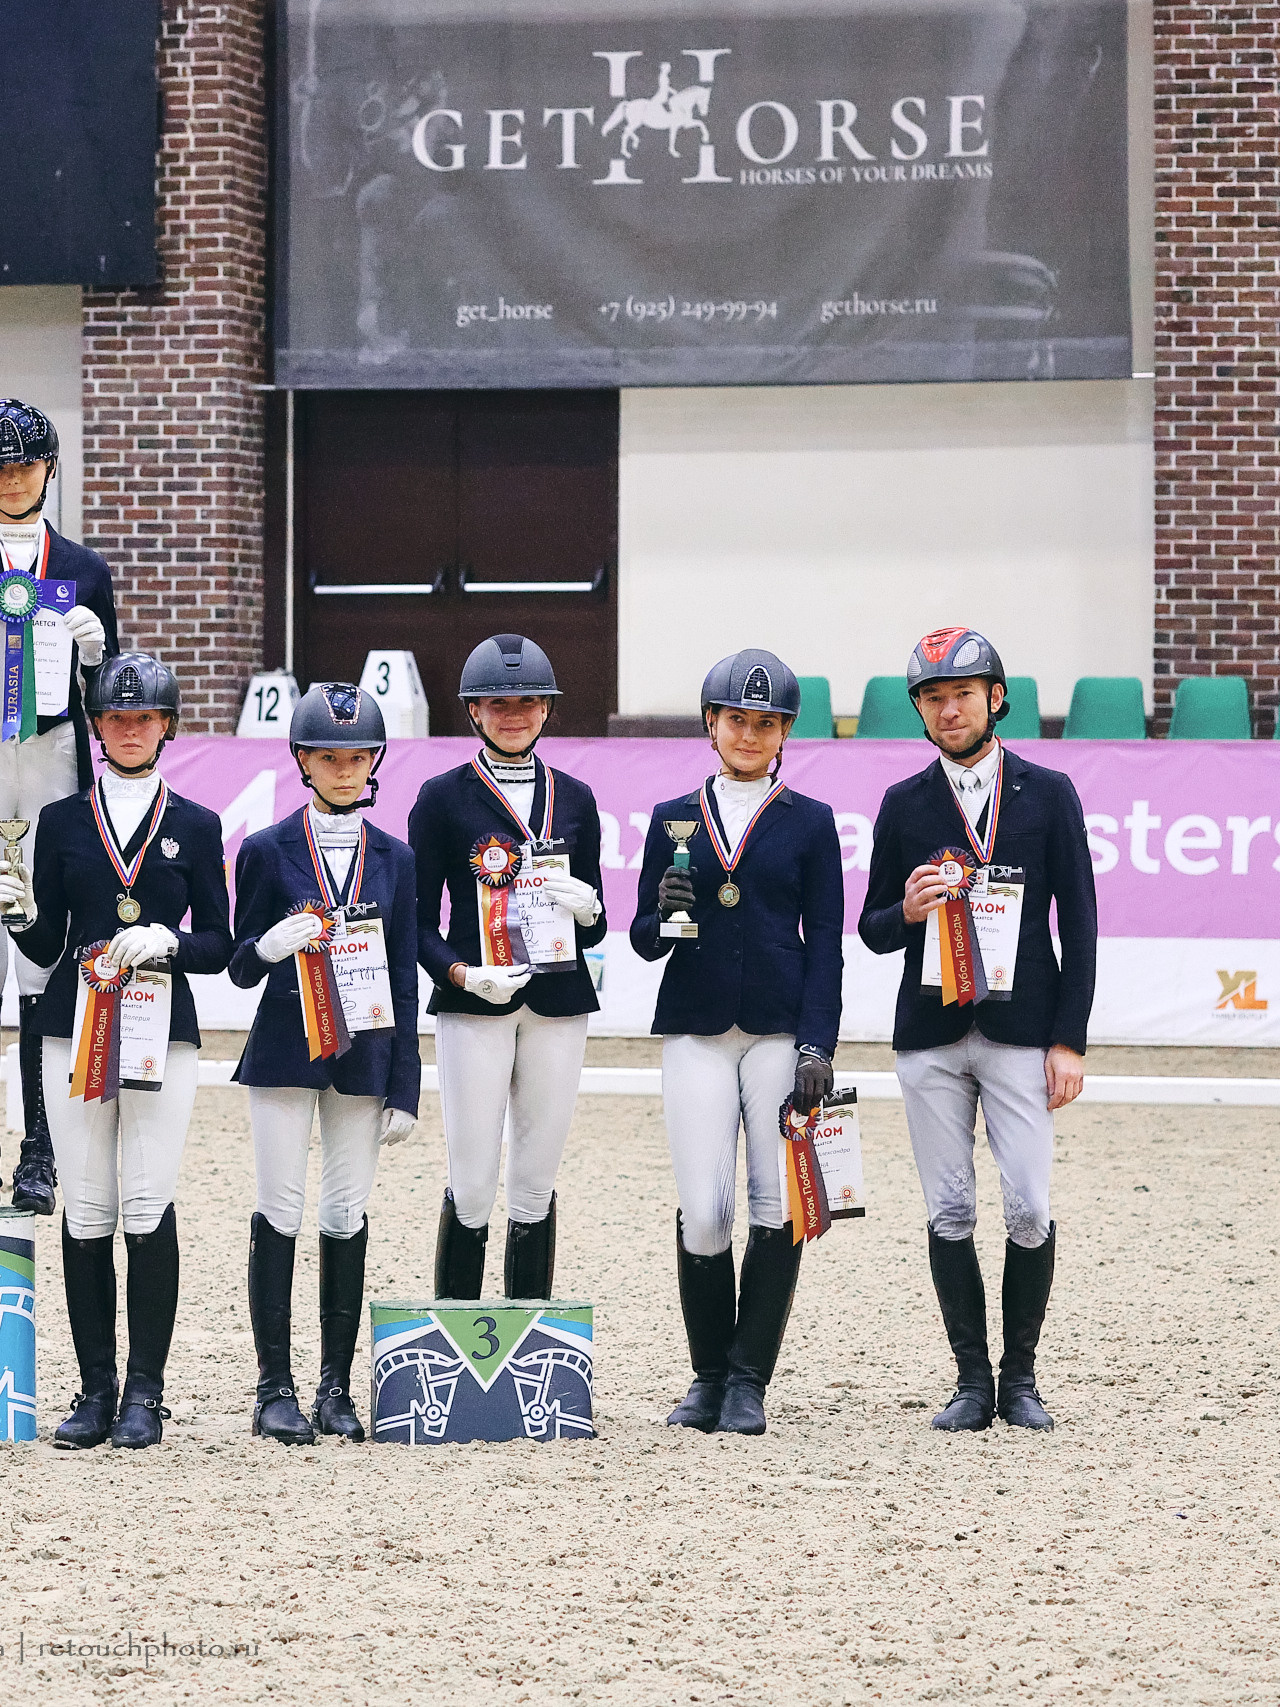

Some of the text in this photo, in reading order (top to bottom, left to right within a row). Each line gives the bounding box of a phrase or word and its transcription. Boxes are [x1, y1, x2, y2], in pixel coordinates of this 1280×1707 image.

[412, 107, 595, 172] GET
[740, 162, 993, 186] HORSES OF YOUR DREAMS
[456, 292, 938, 329] get_horse +7 (925) 249-99-94 gethorse.ru
[7, 664, 19, 723] EURASIA
[255, 686, 279, 721] 12
[376, 661, 391, 696] 3
[1084, 800, 1280, 875] ster
[493, 897, 502, 937] Победы
[329, 942, 368, 955] ПЛОМ
[952, 913, 972, 994] Кубок Победы
[313, 966, 332, 1046] Кубок Победы
[90, 1008, 108, 1089] Кубок Победы
[798, 1151, 818, 1229] Кубок Победы
[471, 1315, 502, 1361] 3
